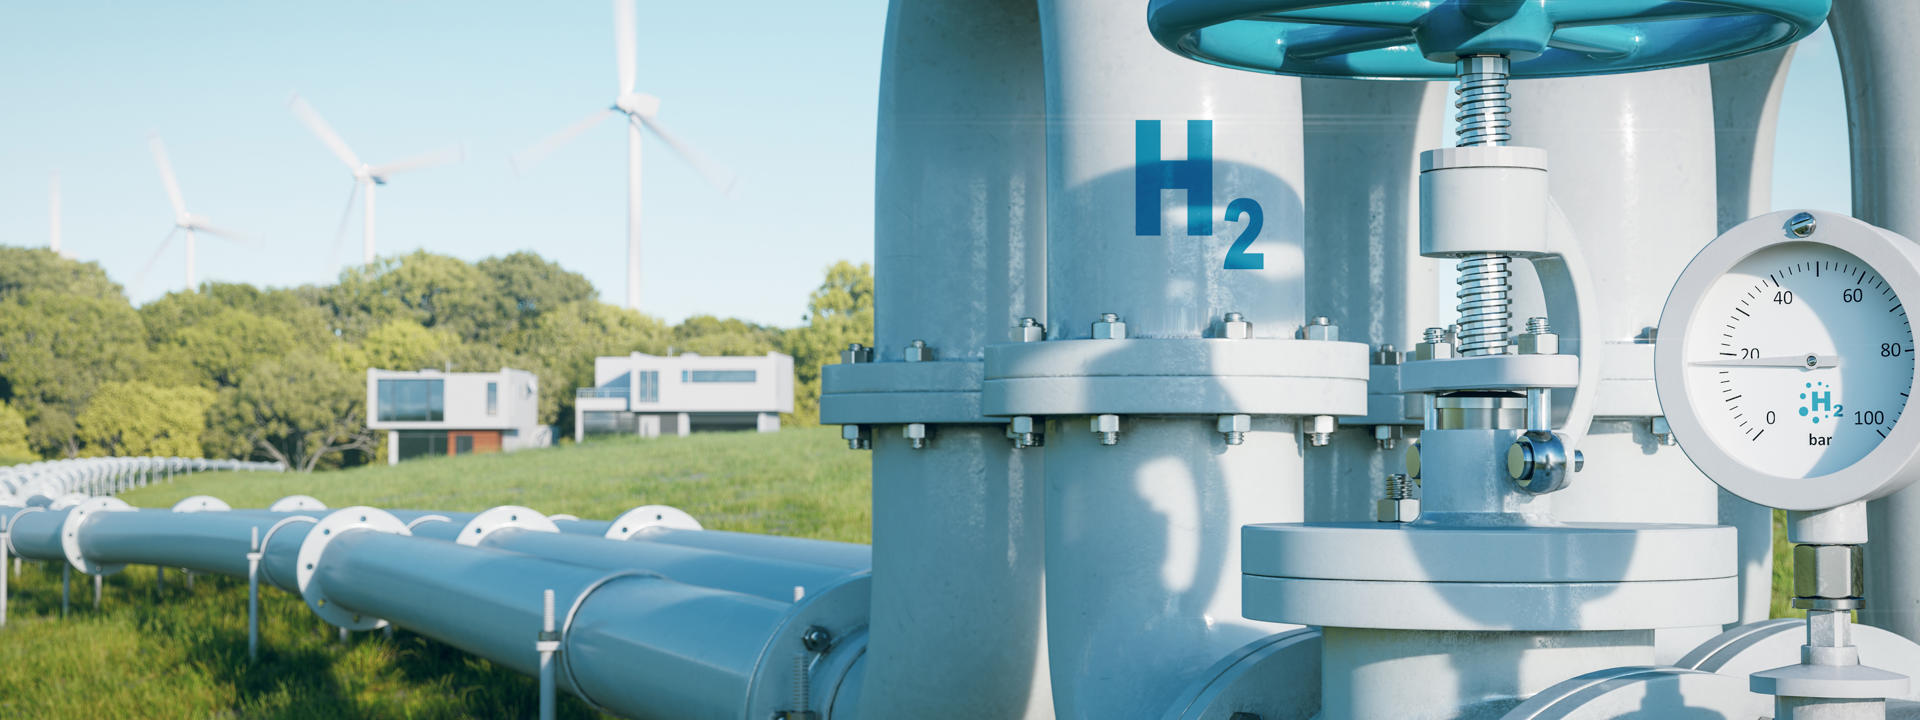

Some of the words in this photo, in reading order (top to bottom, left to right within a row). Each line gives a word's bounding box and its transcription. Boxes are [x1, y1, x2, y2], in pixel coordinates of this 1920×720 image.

[1773, 290, 1793, 305] 40
[1843, 288, 1863, 303] 60
[1741, 348, 1760, 360] 20
[1881, 343, 1901, 358] 80
[1766, 411, 1776, 425] 0
[1854, 411, 1884, 425] 100
[1809, 433, 1832, 446] bar
